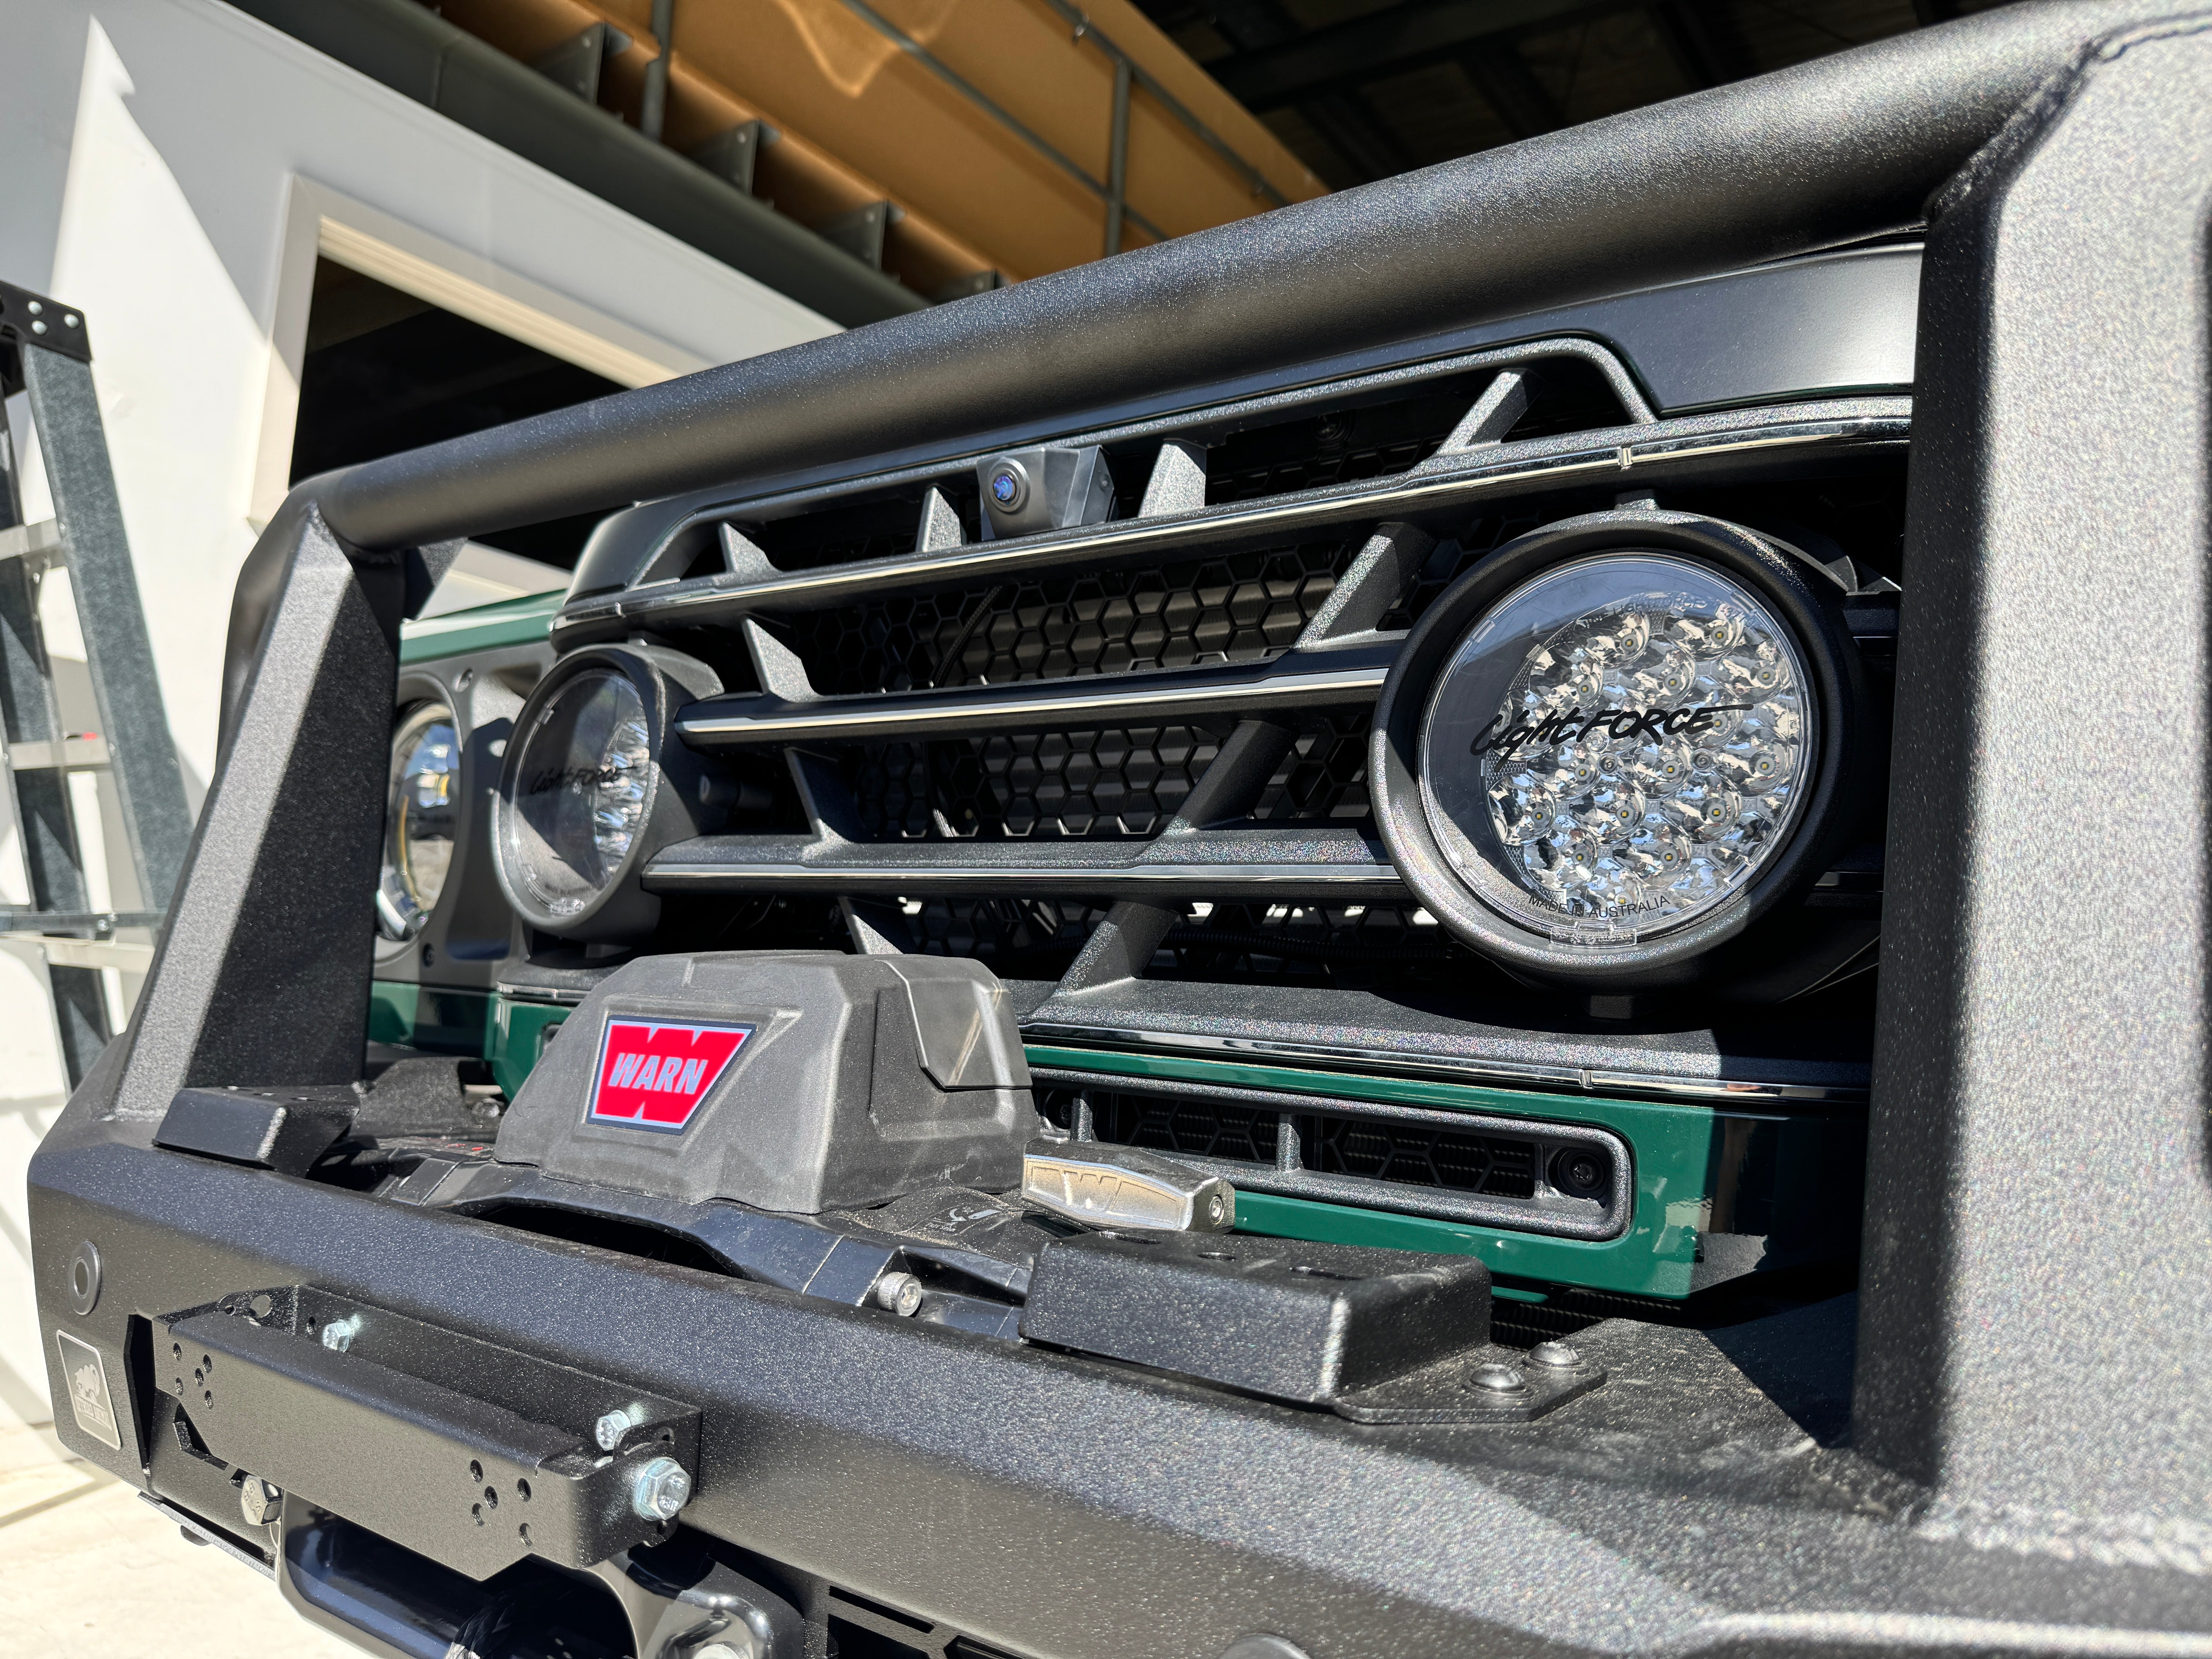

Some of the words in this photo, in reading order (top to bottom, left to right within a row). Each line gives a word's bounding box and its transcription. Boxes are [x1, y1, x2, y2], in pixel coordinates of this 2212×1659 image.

[1528, 893, 1568, 914] MADE
[1571, 903, 1585, 917] IN
[1589, 895, 1671, 918] AUSTRALIA
[608, 1053, 708, 1094] WARN
